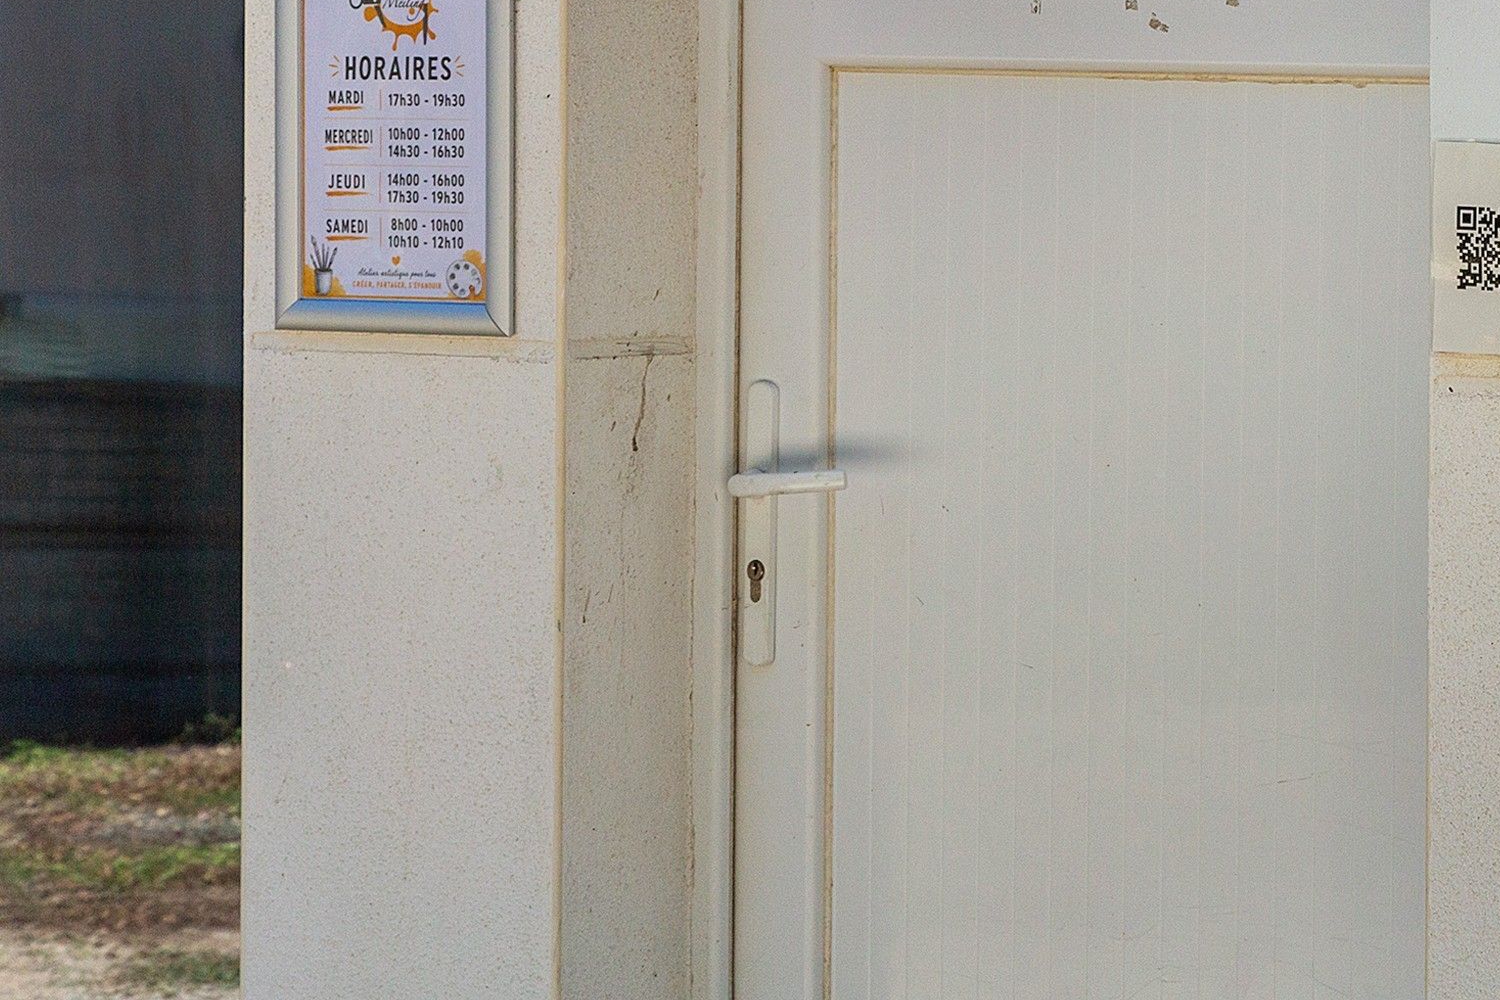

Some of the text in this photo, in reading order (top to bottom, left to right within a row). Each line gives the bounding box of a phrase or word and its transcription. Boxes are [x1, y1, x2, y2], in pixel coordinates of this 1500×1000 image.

[345, 56, 452, 80] HORAIRES
[328, 90, 364, 104] MARDI
[388, 93, 421, 107] 17h30
[432, 93, 466, 107] 19h30
[325, 129, 373, 144] MERCREDI
[388, 127, 420, 141] 10h00
[432, 127, 465, 141] 12h00
[388, 145, 420, 158] 14h30
[432, 145, 465, 158] 16h30
[328, 174, 366, 189] JEUDI
[387, 173, 420, 187] 14h00
[432, 174, 465, 187] 16h00
[387, 190, 420, 203] 17h30
[431, 191, 464, 204] 19h30
[326, 219, 368, 233] SAMEDI
[390, 218, 418, 231] 8h00
[430, 218, 464, 232] 10h00
[388, 235, 419, 249] 10h10
[432, 236, 464, 249] 12h10
[410, 271, 424, 280] pour
